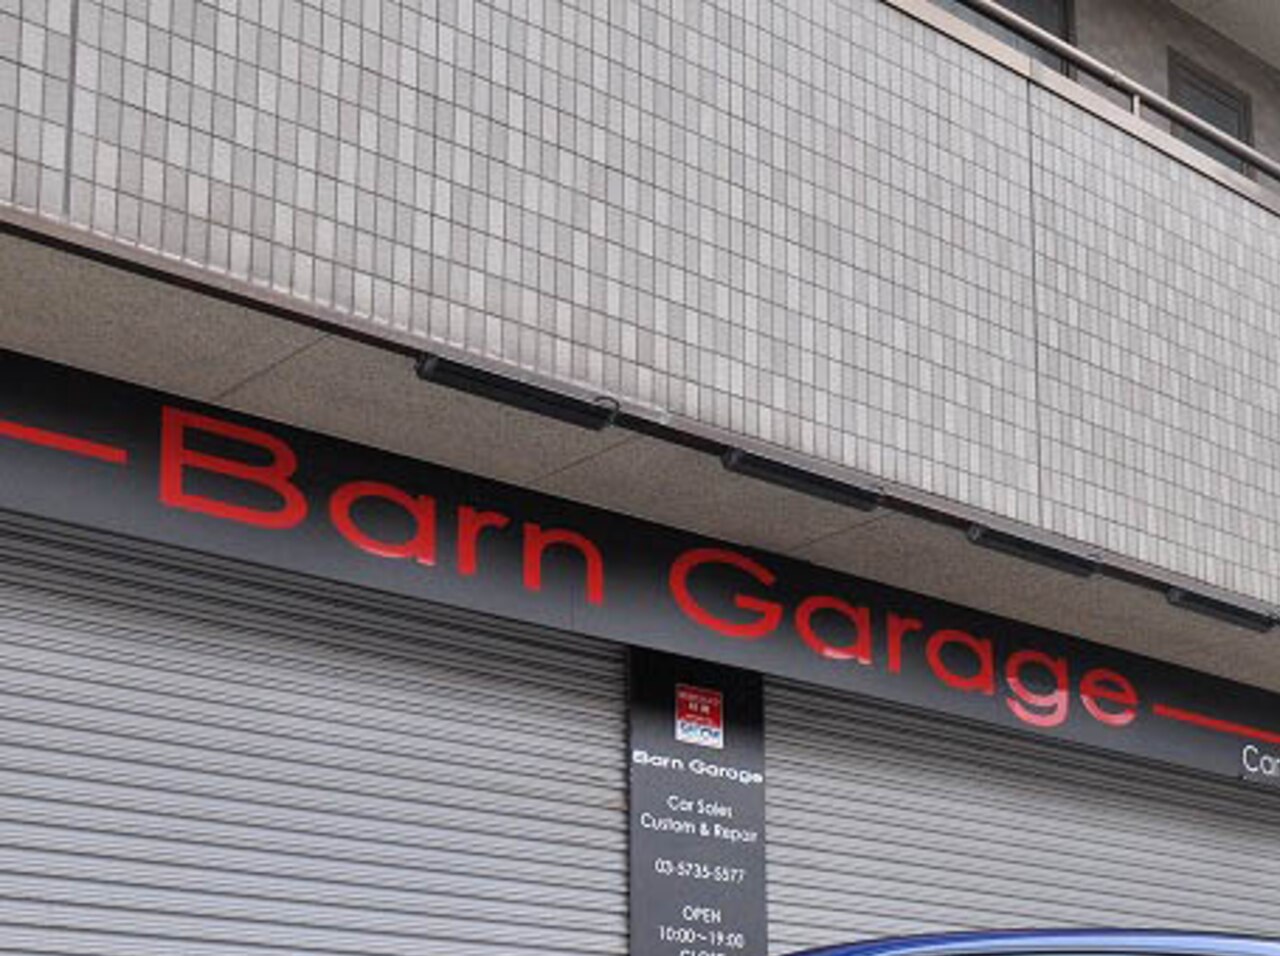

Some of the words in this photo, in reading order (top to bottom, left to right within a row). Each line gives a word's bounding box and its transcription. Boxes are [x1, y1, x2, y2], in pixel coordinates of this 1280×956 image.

[158, 404, 605, 606] Barn
[668, 547, 1140, 727] Garage
[632, 750, 684, 769] Barn
[688, 758, 763, 784] Garage
[1242, 744, 1280, 776] Car
[667, 795, 693, 812] Car
[697, 799, 732, 819] Sales
[641, 812, 696, 834] Custom
[714, 823, 757, 844] Repair
[655, 857, 746, 884] 03-5735-5577
[682, 904, 721, 924] OPEN
